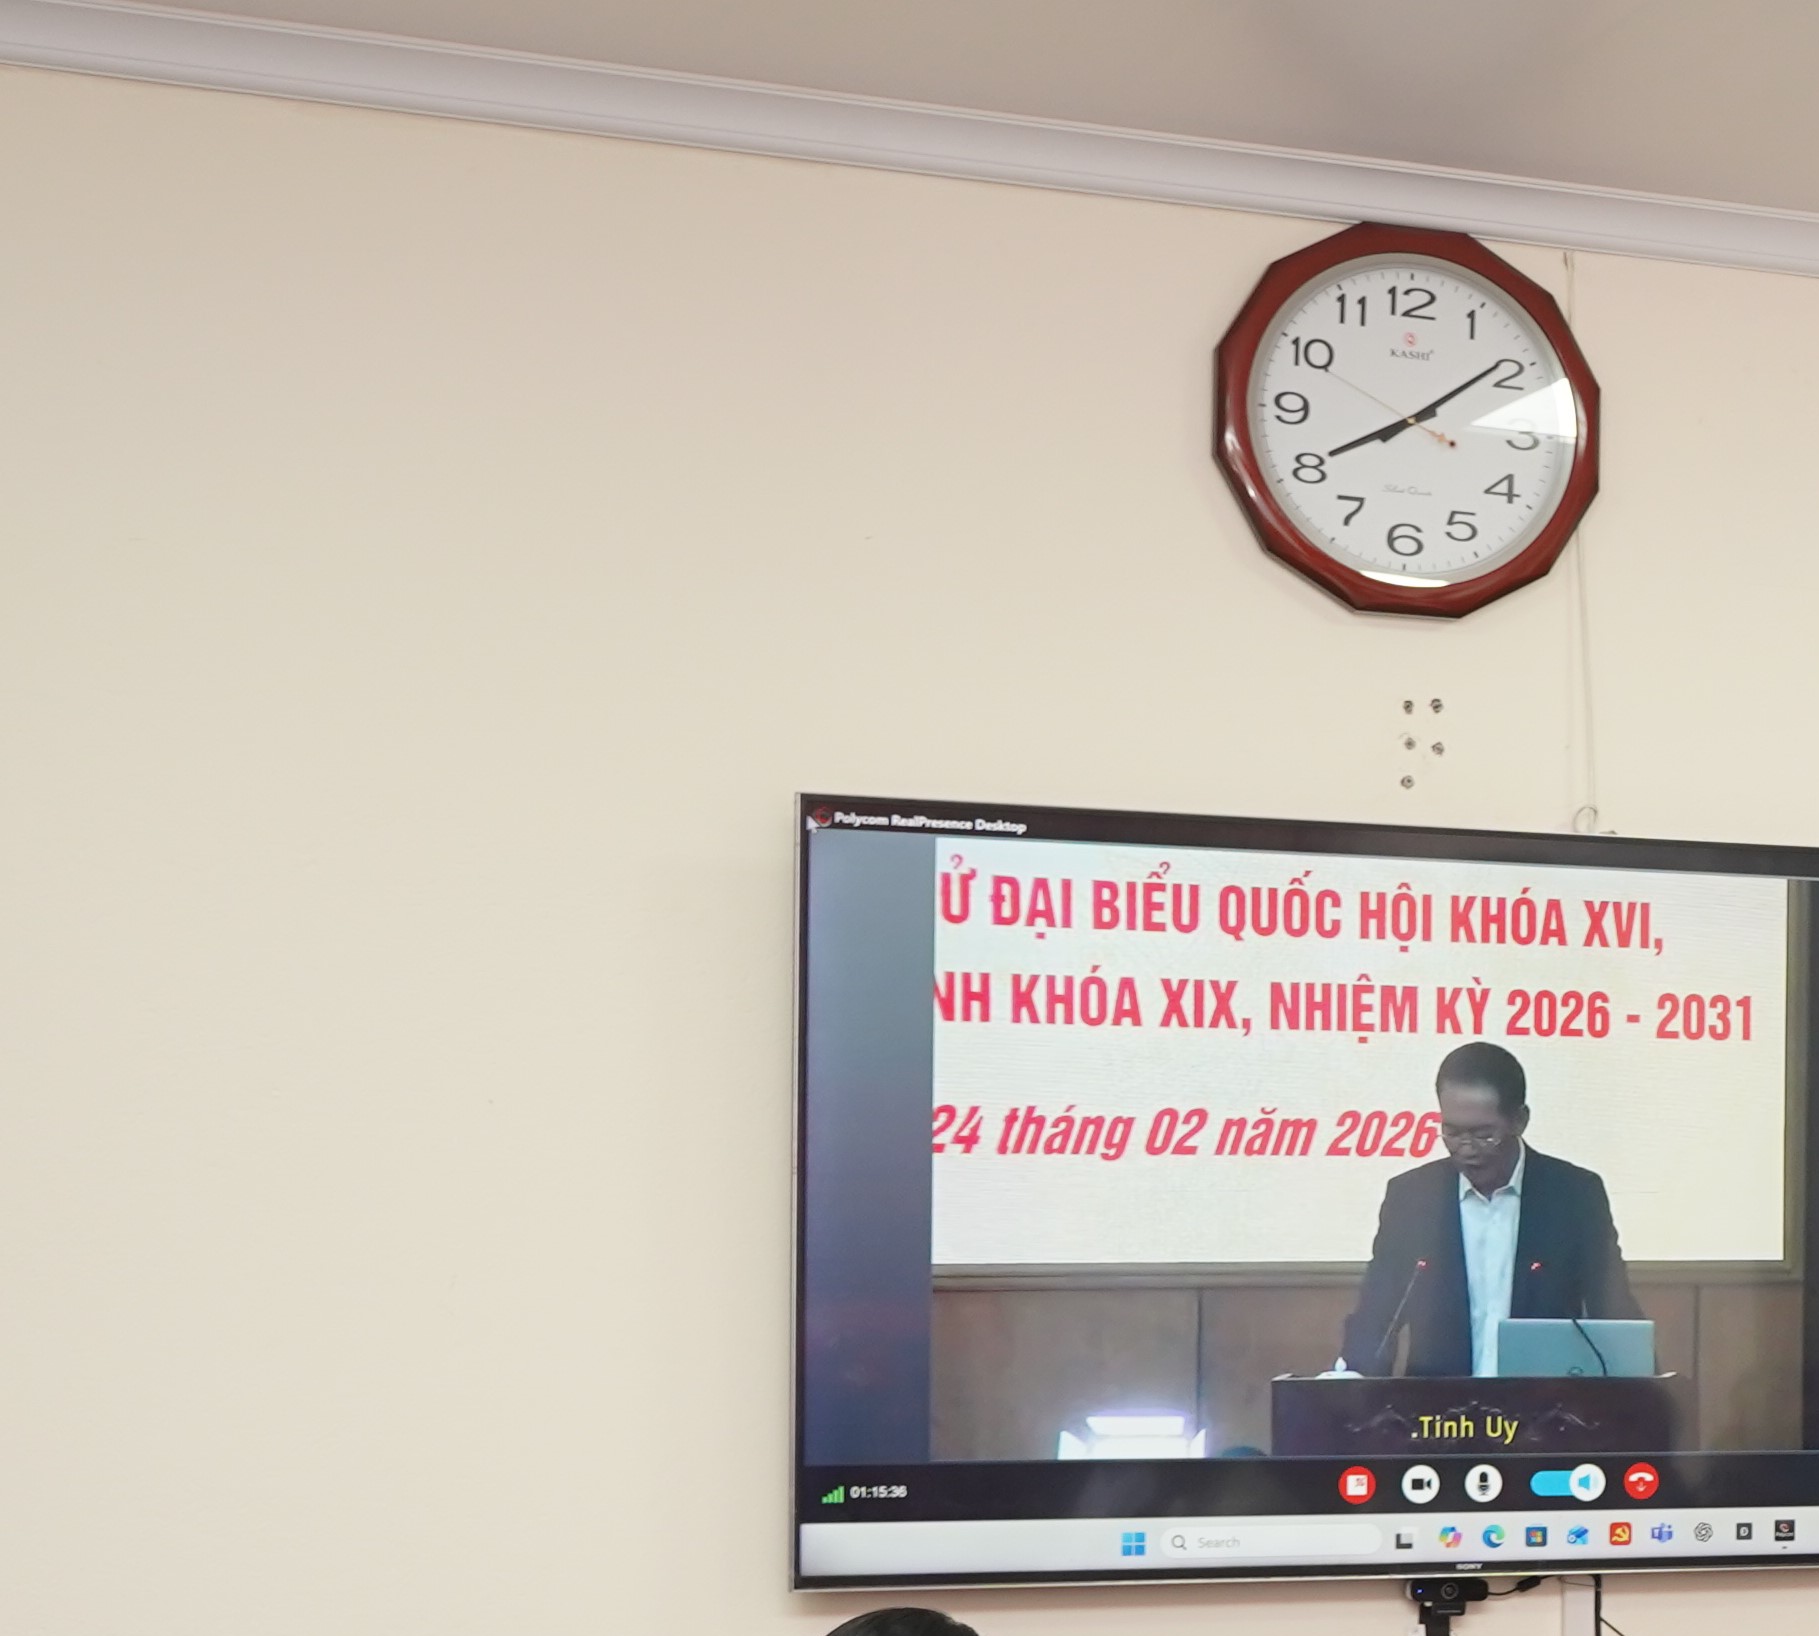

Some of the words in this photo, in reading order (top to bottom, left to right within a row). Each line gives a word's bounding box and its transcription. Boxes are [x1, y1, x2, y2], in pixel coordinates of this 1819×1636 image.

[1336, 292, 1368, 327] 11
[1386, 285, 1438, 321] 12
[1465, 308, 1477, 340] 1
[1291, 336, 1335, 370] 10
[1492, 357, 1526, 391] 2
[1273, 390, 1311, 425] 9
[1504, 417, 1541, 451] 3
[1291, 451, 1328, 485] 8
[1483, 473, 1522, 505] 4
[1335, 493, 1367, 527] 7
[1443, 510, 1479, 542] 5
[1385, 522, 1425, 557] 6
[833, 811, 890, 828] Polycom
[890, 813, 973, 831] RealPresence
[974, 817, 1028, 836] Desktop
[989, 875, 1073, 940] ĐẠI
[1092, 861, 1200, 934] BIỂU
[1218, 870, 1342, 941] QUỐC
[1359, 883, 1432, 953] HỘI
[1451, 887, 1568, 947] KHÓA
[1583, 900, 1664, 955] XVI,
[1011, 965, 1142, 1027] KHÓA
[1160, 978, 1252, 1036] XIX,
[1270, 974, 1418, 1043] NHIỆM
[1436, 977, 1491, 1035] KỲ
[1506, 989, 1610, 1039] 2026
[1626, 1014, 1640, 1024] -
[1656, 993, 1752, 1041] 2031
[933, 1104, 982, 1155] 24
[997, 1105, 1135, 1161] tháng
[1146, 1107, 1208, 1156] 02
[1215, 1109, 1318, 1157] năm
[1326, 1111, 1441, 1158] 2026
[1197, 1536, 1241, 1549] Search
